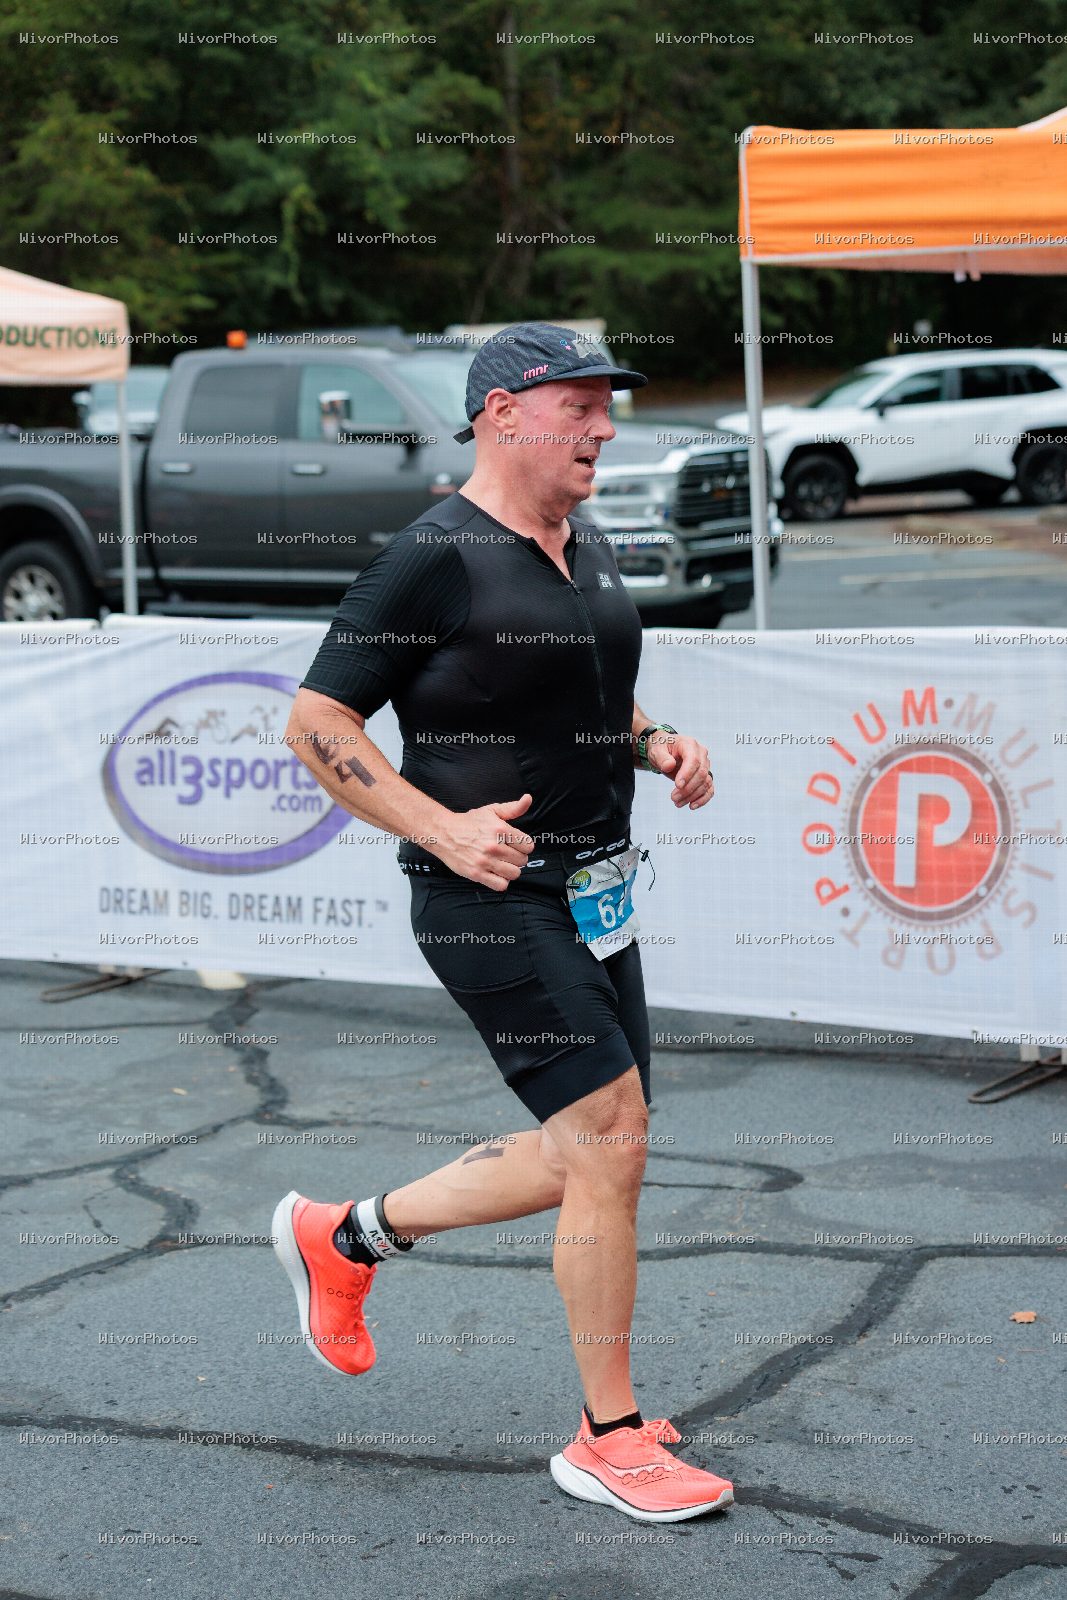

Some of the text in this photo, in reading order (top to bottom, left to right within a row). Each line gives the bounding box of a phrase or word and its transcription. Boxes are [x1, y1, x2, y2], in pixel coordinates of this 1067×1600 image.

[523, 363, 549, 381] rnnr
[134, 749, 319, 805] all3sports
[271, 794, 323, 814] .com
[802, 686, 938, 906] PODIUM
[841, 692, 1061, 976] MULTISPORT
[893, 771, 972, 888] P
[100, 887, 170, 918] DREAM
[178, 890, 219, 920] BIG.
[228, 893, 304, 925] DREAM
